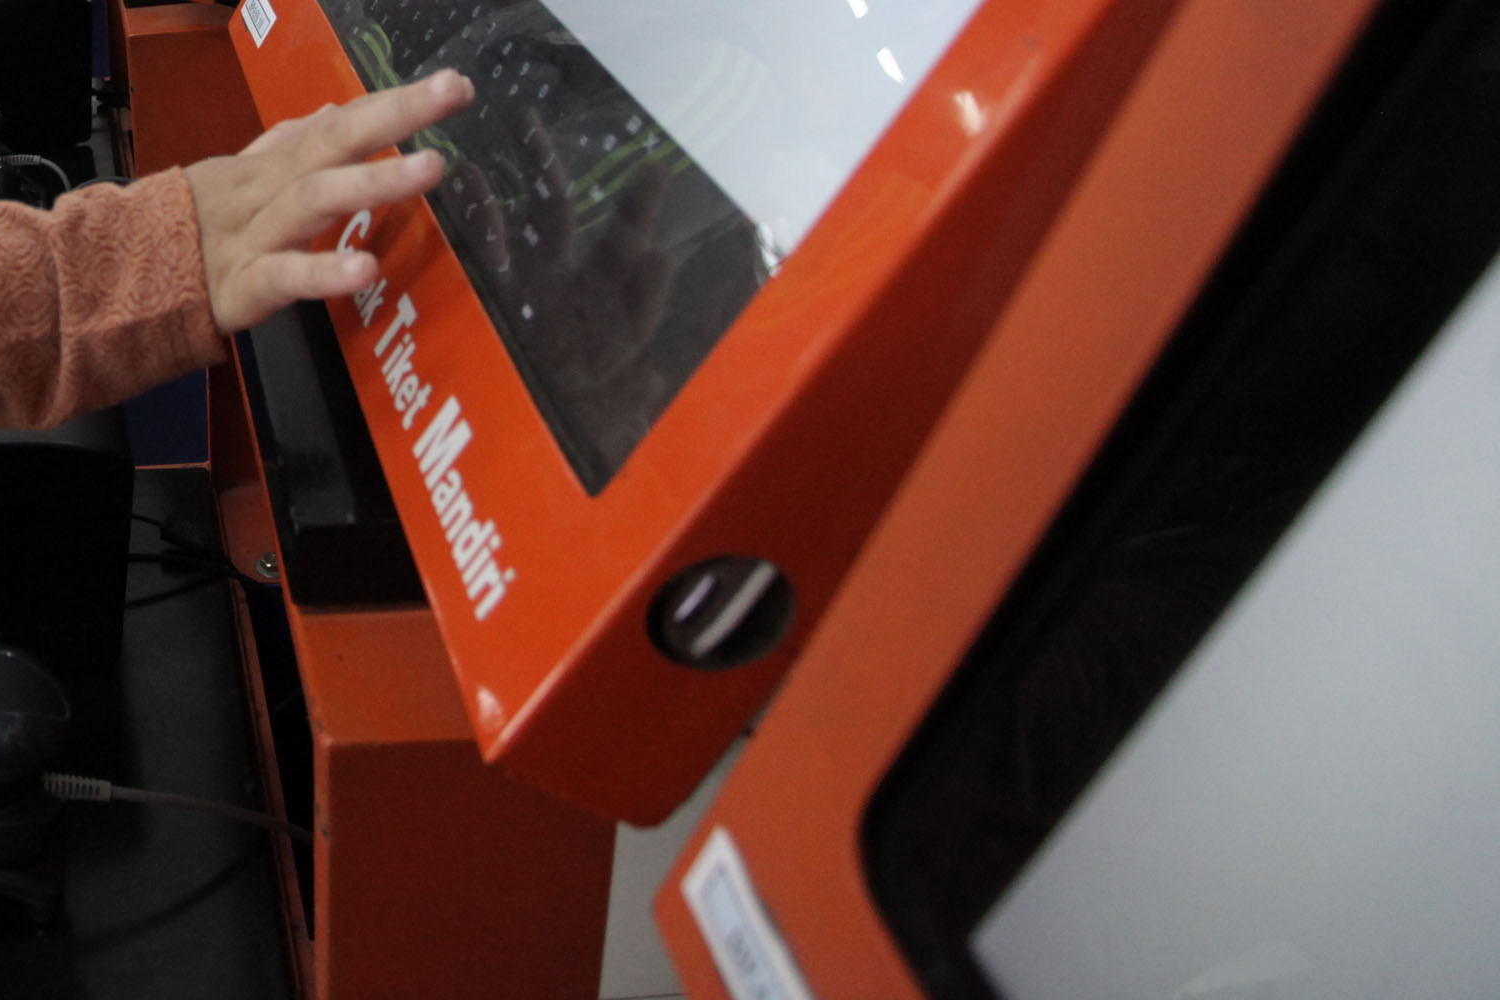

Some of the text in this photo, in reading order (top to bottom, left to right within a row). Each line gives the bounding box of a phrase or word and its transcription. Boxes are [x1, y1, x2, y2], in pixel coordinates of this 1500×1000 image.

[336, 208, 516, 622] Cak Tiket Mandiri
